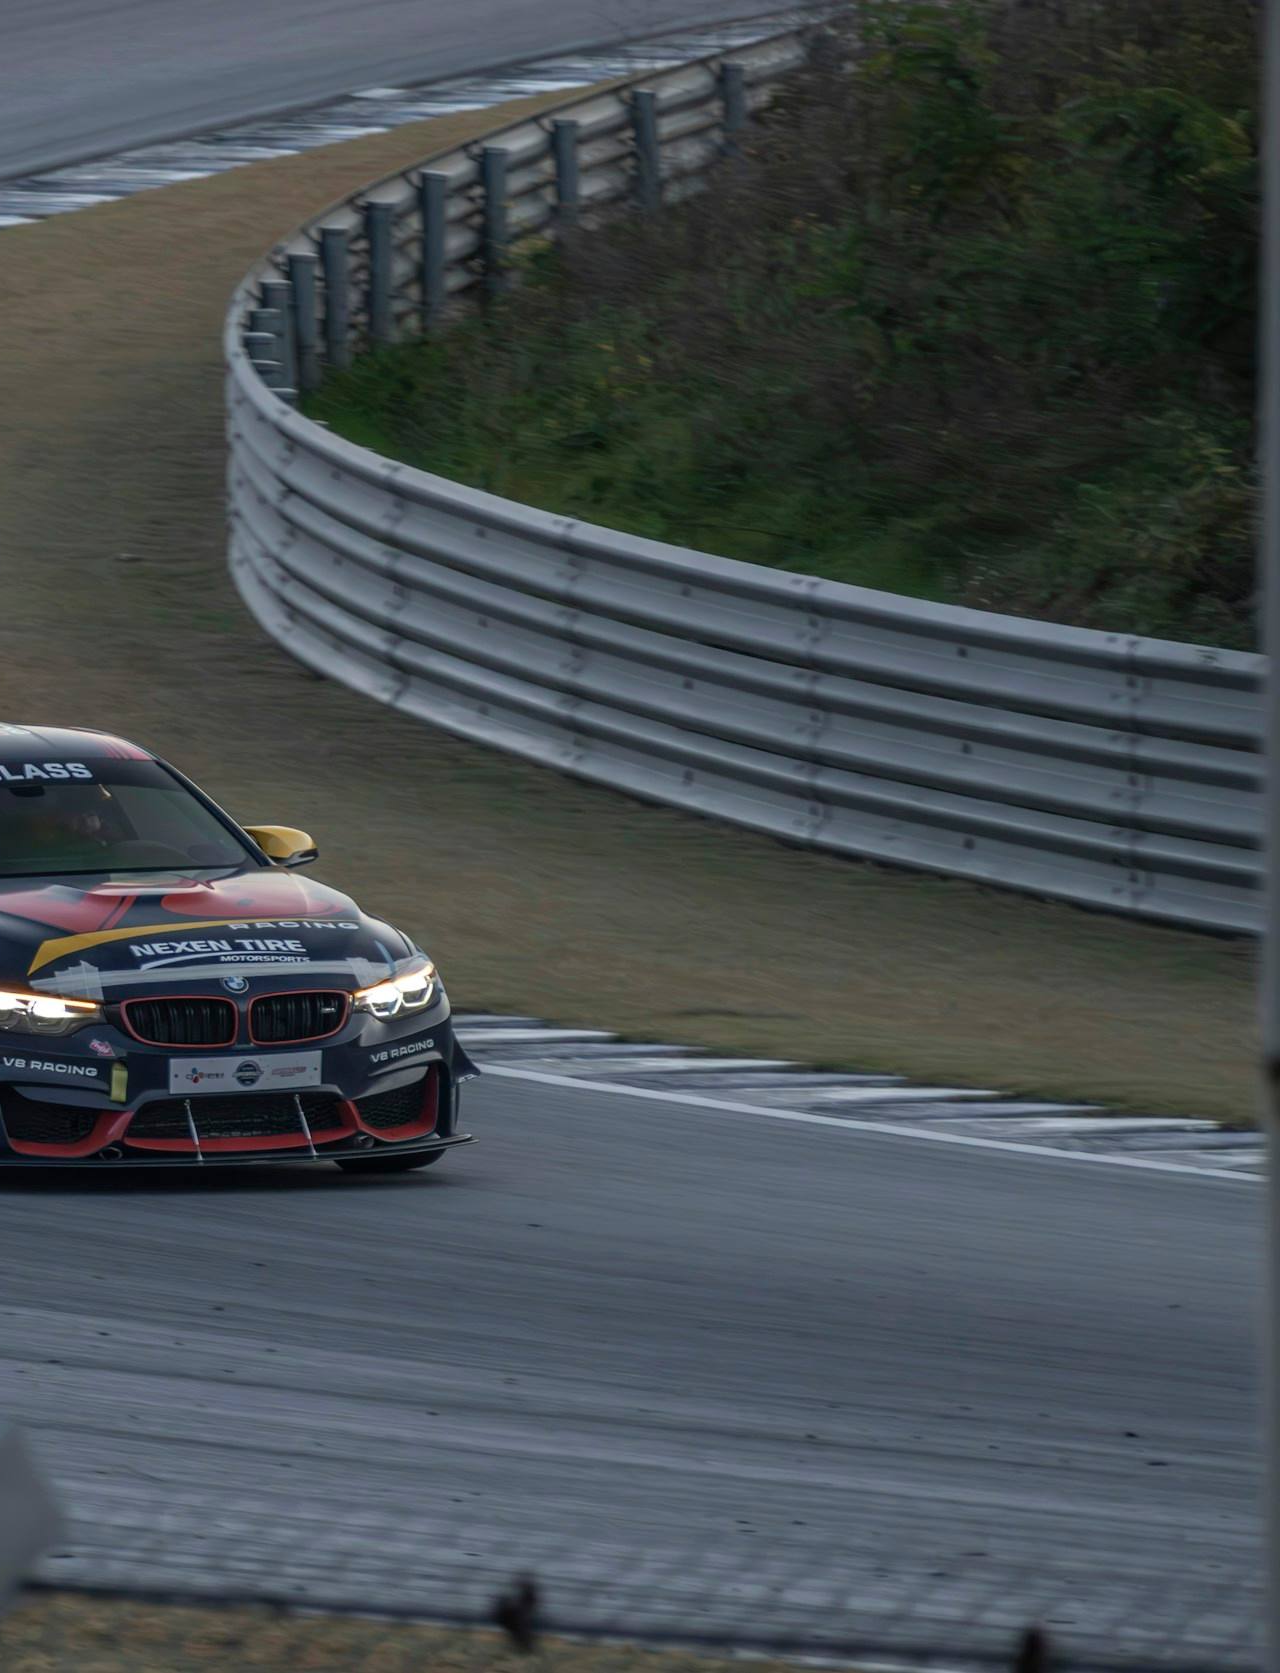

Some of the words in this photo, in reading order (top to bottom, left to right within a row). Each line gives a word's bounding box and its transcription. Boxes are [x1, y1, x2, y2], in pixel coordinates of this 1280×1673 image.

[228, 921, 360, 930] RACING
[129, 939, 233, 957] NEXEN
[235, 939, 307, 952] TIRE
[220, 955, 311, 963] MOTORSPORTS
[391, 1038, 435, 1058] RACING
[30, 1060, 98, 1077] RACING
